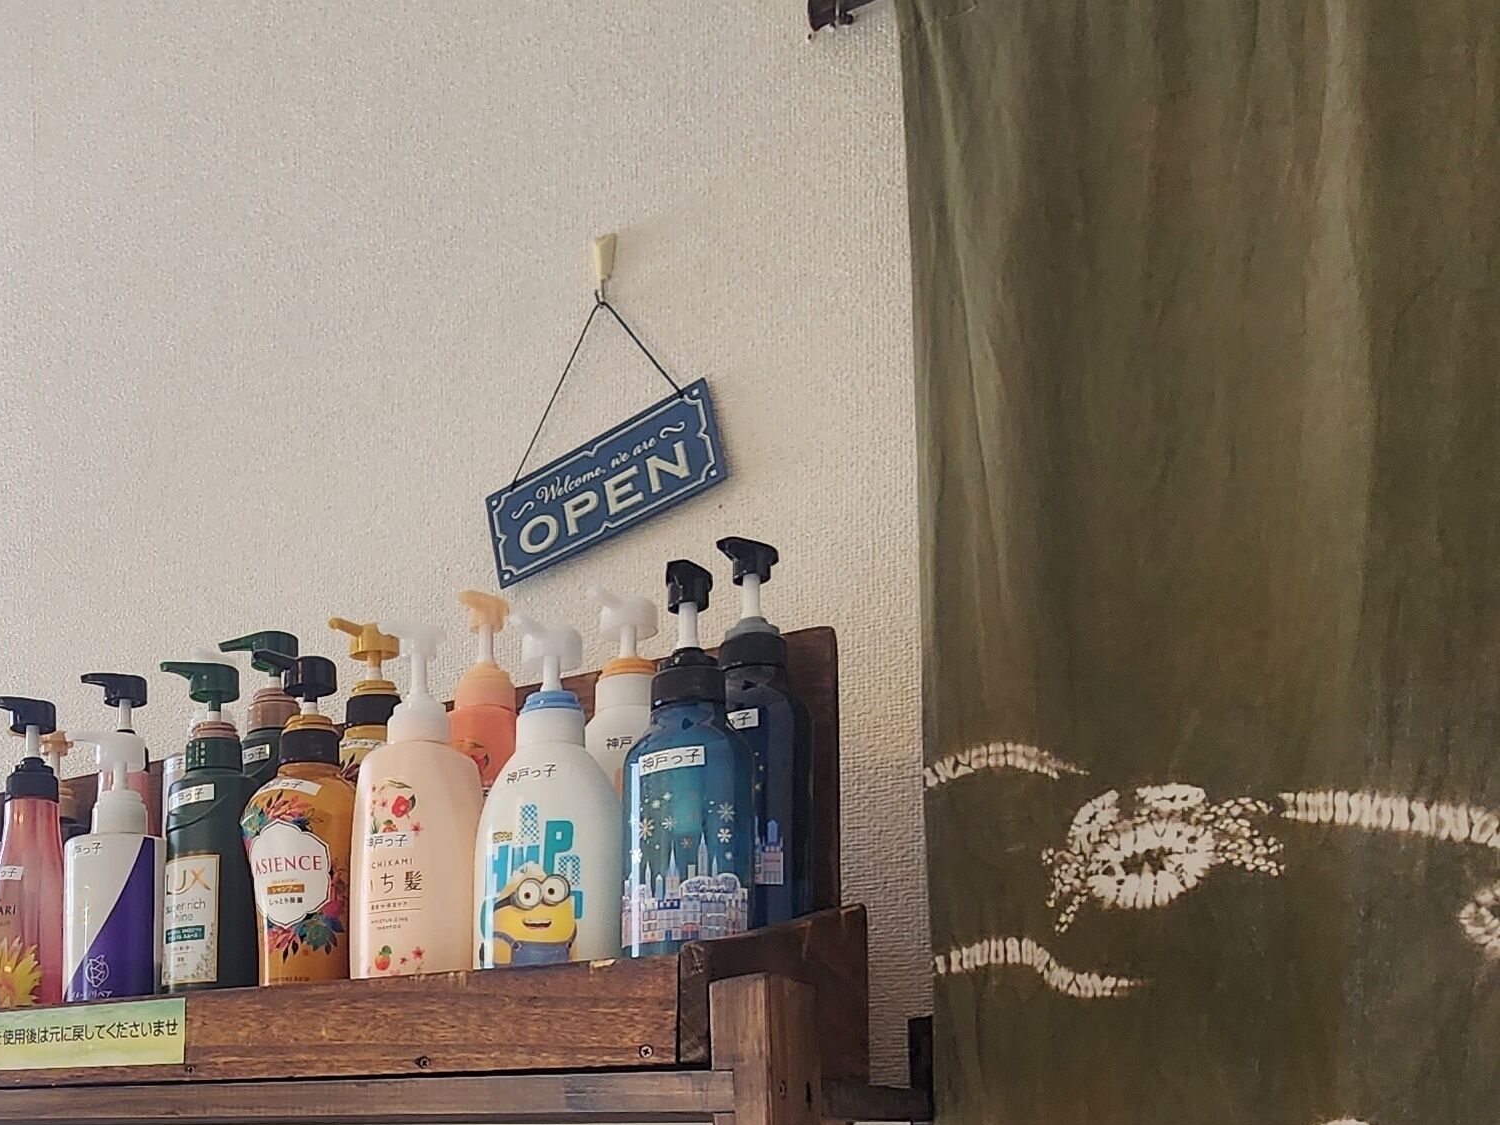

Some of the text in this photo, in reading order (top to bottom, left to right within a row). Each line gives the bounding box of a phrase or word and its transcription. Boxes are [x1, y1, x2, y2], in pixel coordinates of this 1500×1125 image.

[536, 436, 657, 504] Welcome, we are
[519, 440, 691, 554] OPEN
[642, 748, 701, 770] 神戸っ子
[506, 763, 557, 784] 神戸っ子
[255, 855, 323, 876] ASIENCE
[371, 857, 413, 870] CHIKAMI
[166, 866, 212, 896] LUX
[187, 898, 206, 911] rich
